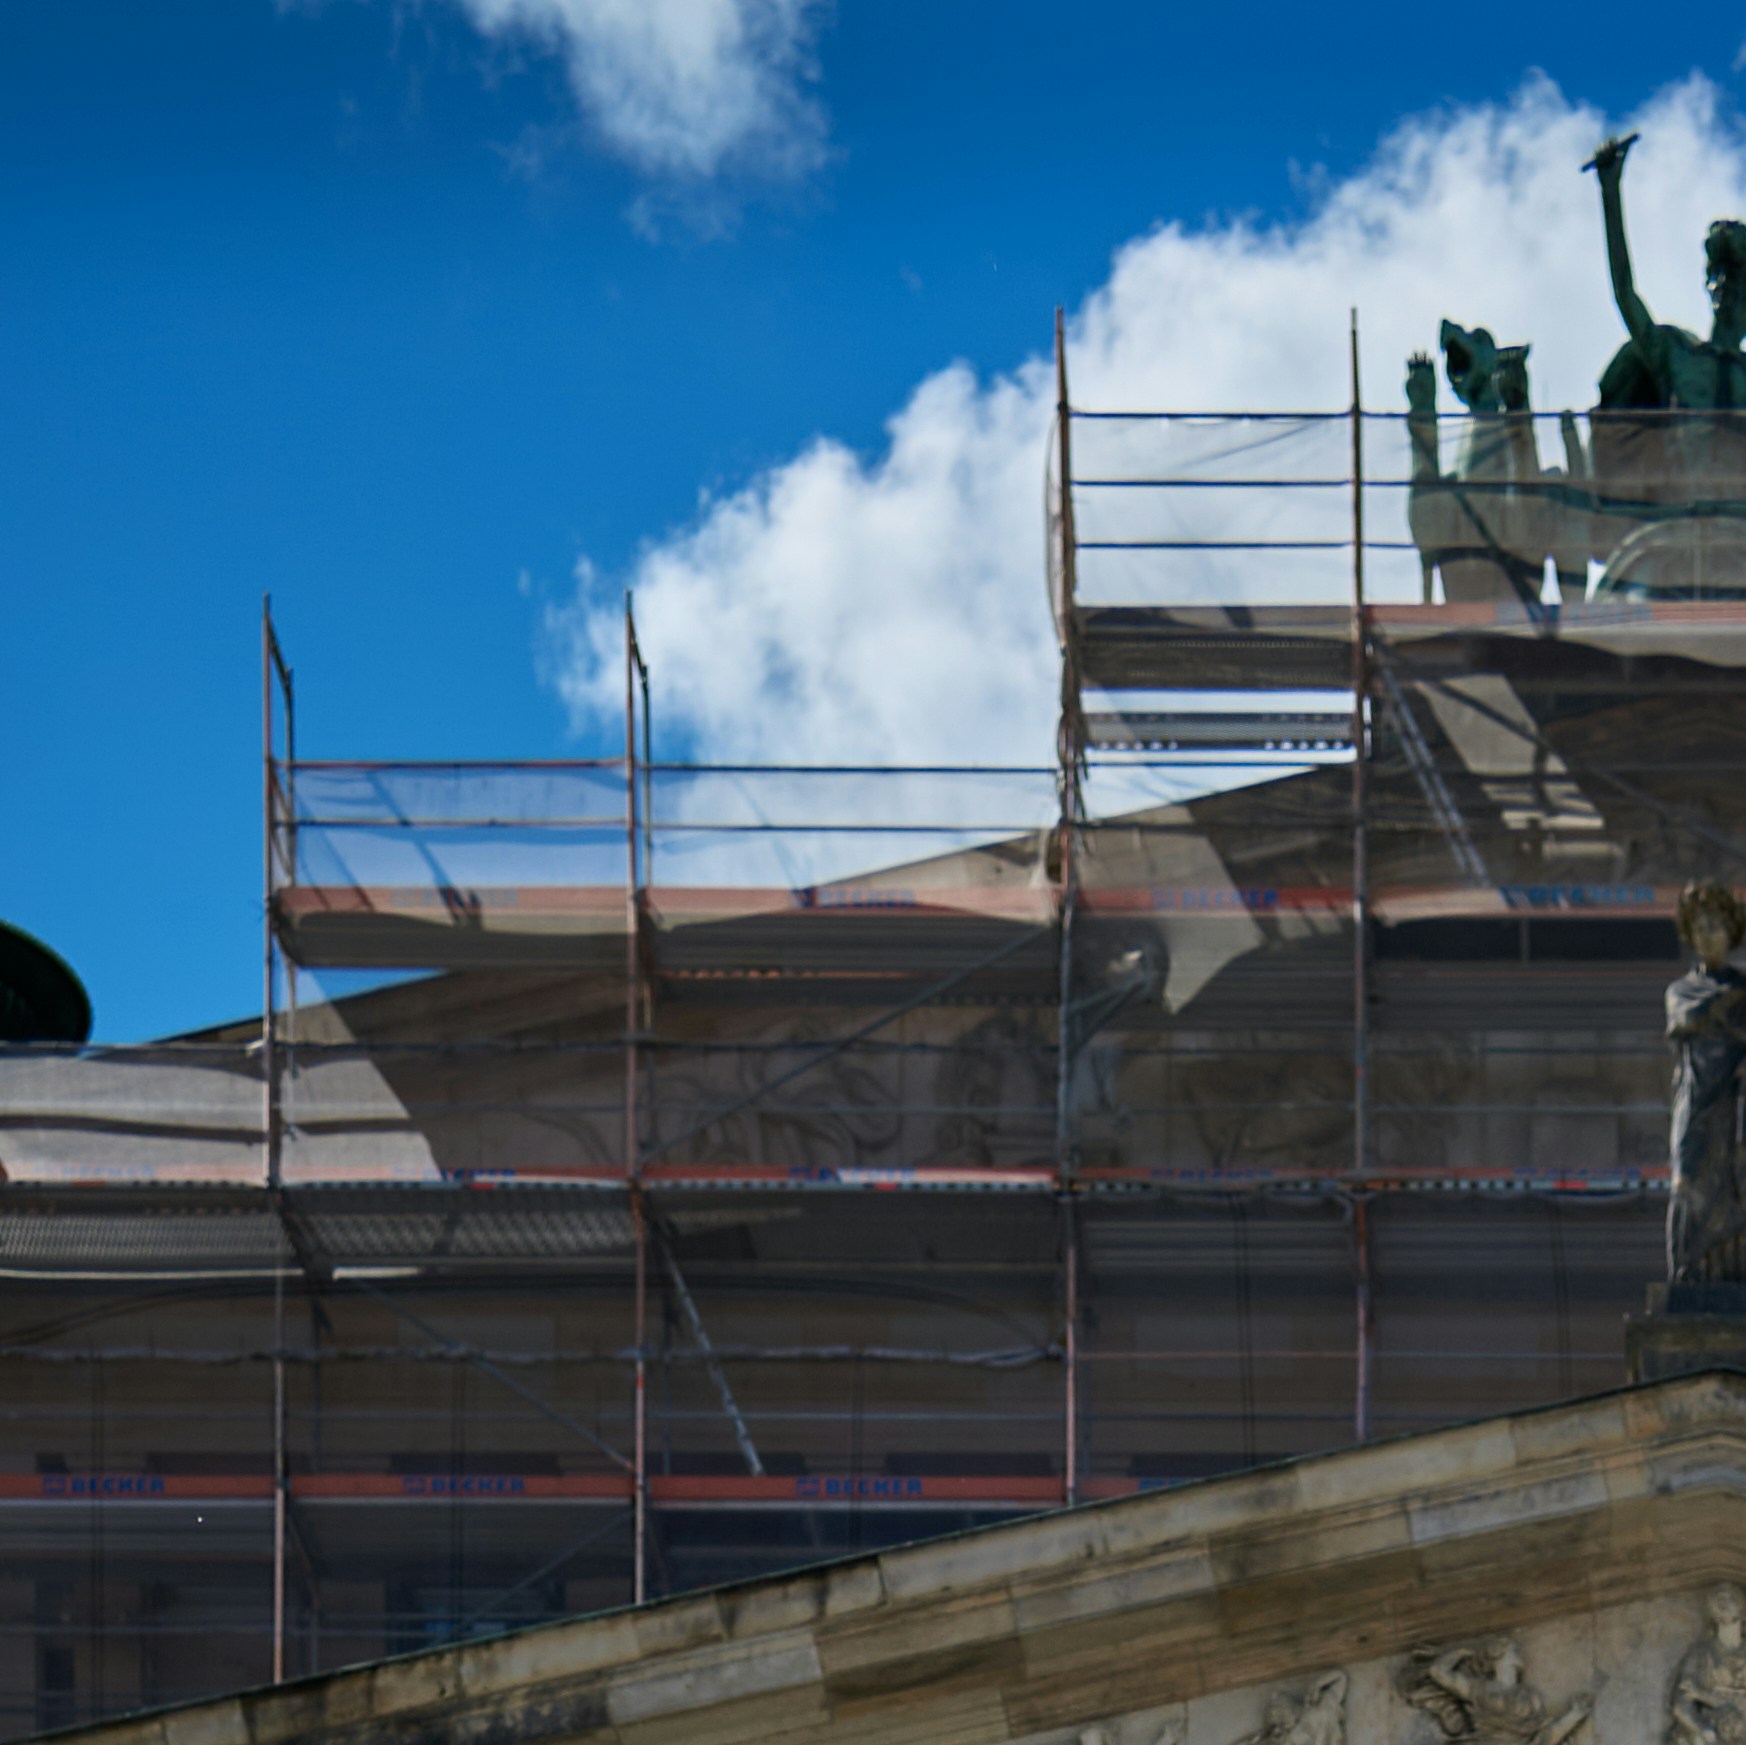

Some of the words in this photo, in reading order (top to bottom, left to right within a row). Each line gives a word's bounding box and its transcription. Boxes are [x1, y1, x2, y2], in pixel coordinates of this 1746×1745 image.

[71, 1477, 166, 1494] BECKER
[431, 1476, 526, 1494] BECKER
[825, 1477, 923, 1496] BECKER
